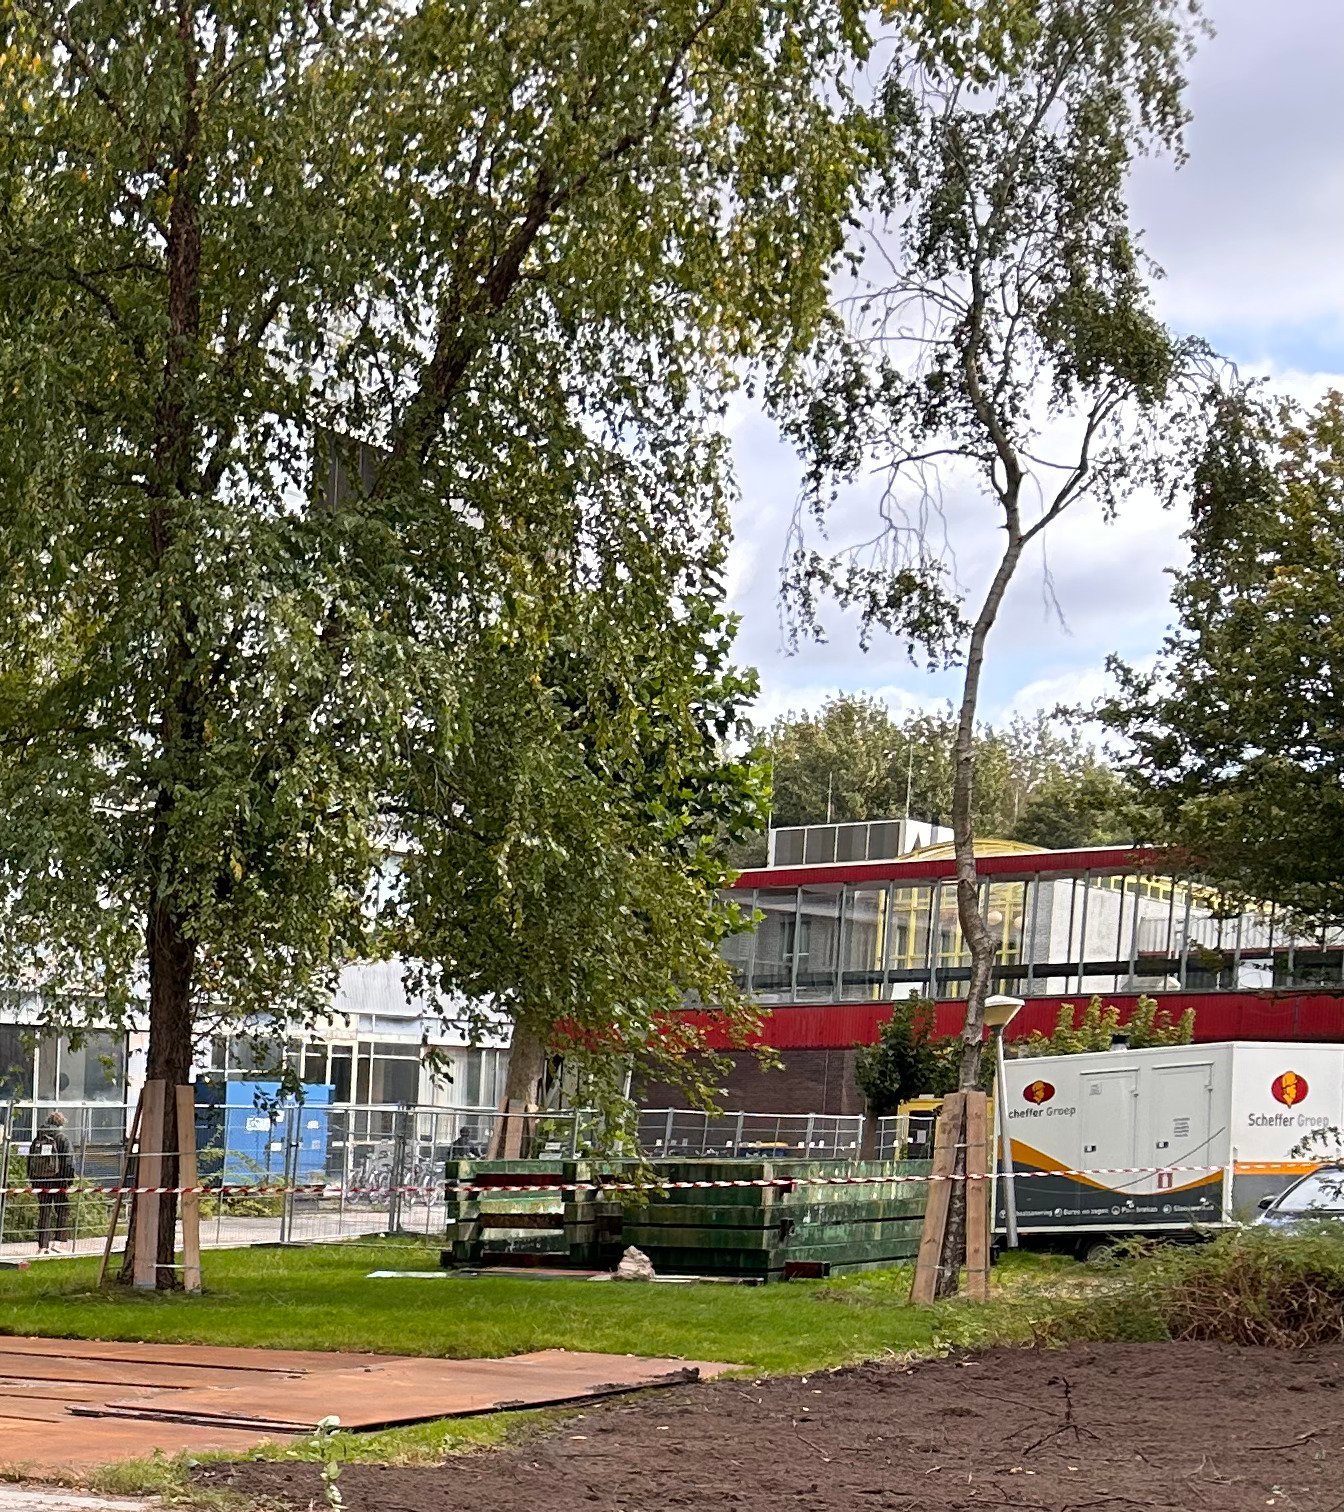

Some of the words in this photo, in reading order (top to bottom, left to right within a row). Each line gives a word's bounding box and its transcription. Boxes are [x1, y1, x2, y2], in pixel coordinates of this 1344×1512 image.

[1008, 1108, 1044, 1119] cheffer
[1046, 1107, 1076, 1117] Groep
[1248, 1112, 1295, 1127] Scheffer
[1297, 1113, 1330, 1127] Groep
